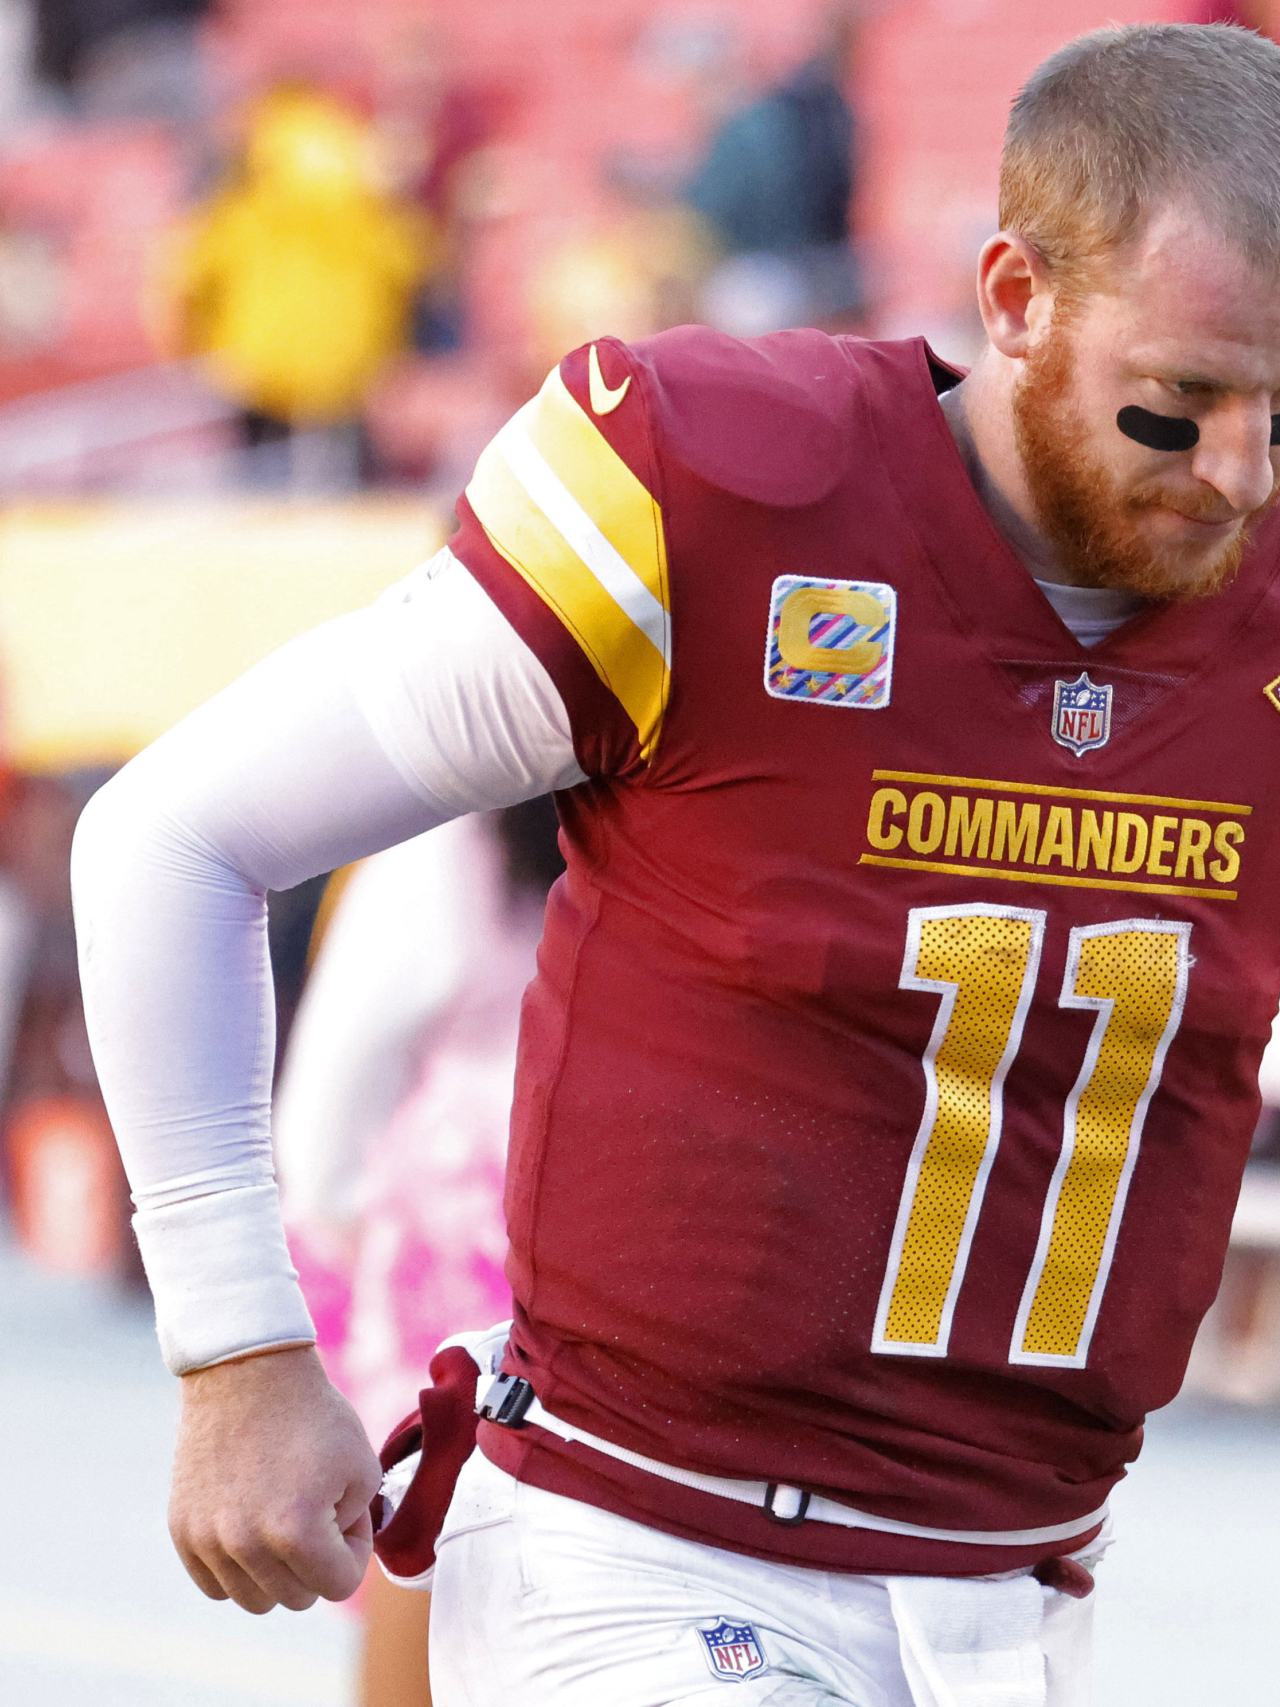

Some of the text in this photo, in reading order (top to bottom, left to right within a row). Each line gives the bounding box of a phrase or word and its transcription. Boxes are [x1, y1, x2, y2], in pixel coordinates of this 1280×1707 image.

[778, 587, 886, 675] C
[1061, 710, 1100, 741] NFL
[866, 787, 1245, 884] COMMANDERS
[870, 902, 1193, 1369] 11
[714, 1644, 759, 1671] NFL
